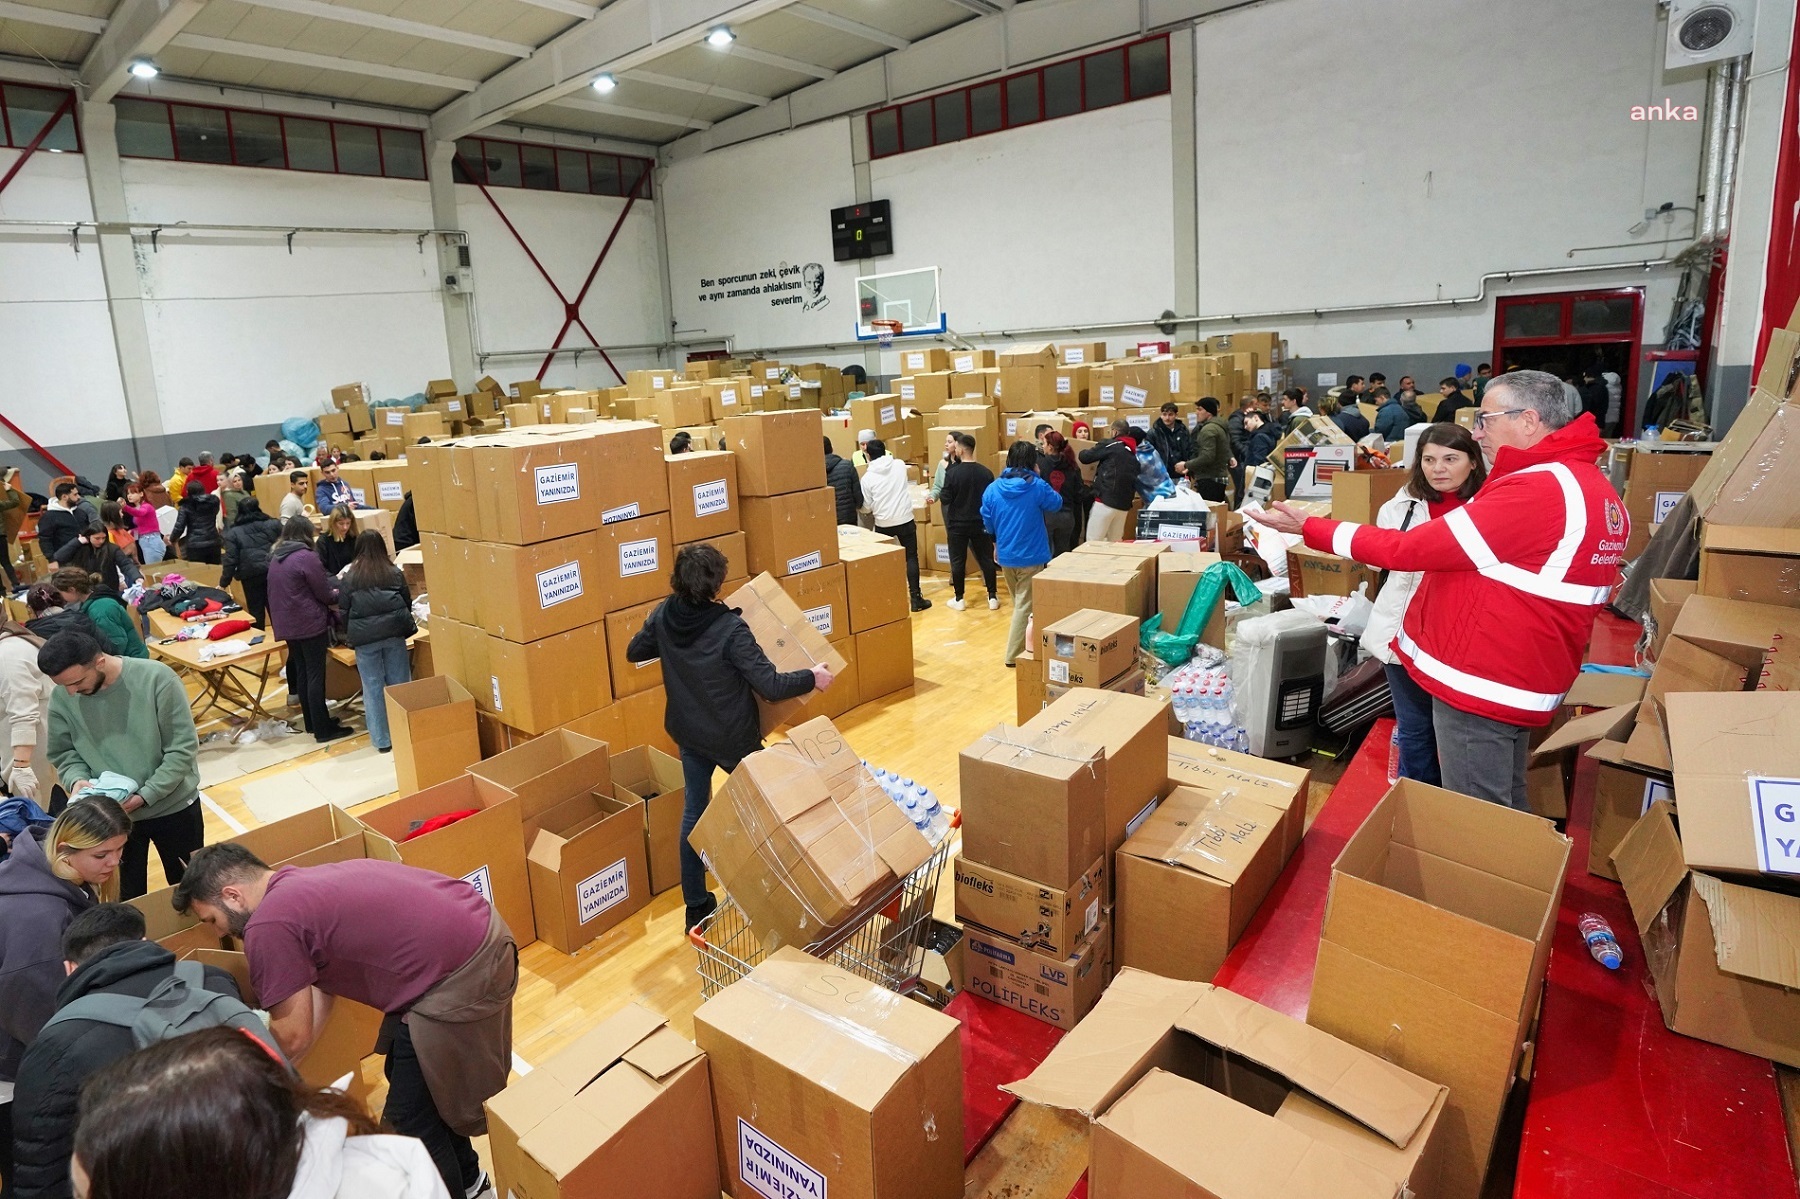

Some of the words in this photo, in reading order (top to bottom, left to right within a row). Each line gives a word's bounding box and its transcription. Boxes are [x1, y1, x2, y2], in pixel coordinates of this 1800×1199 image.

[700, 278, 715, 288] Ben
[718, 273, 757, 287] sporcunun
[779, 264, 800, 278] çevik
[699, 294, 707, 302] ve
[709, 290, 724, 302] aynı
[727, 286, 760, 298] zamanda
[763, 281, 801, 293] ahlaklısını
[771, 295, 802, 306] severim
[540, 471, 575, 484] GAZİEMİR
[541, 485, 576, 497] YANINIZDA
[697, 486, 725, 500] GAZİEMİR
[698, 498, 726, 510] YANINIZDA
[624, 546, 655, 558] GAZİEMİR
[624, 558, 655, 570] YANINIZDA
[791, 558, 818, 571] YANINIZDA
[1303, 560, 1342, 573] AYGAZ
[542, 569, 577, 588] GAZİEMİR
[544, 582, 579, 600] YANINIZDA
[583, 870, 624, 899] GAZİEMİR
[955, 870, 994, 894] biofleks
[584, 885, 624, 914] YANINIZDA
[1042, 965, 1065, 980] LVP
[972, 976, 1060, 1021] POLİFLEKS
[744, 1134, 818, 1197] YANINIZDA
